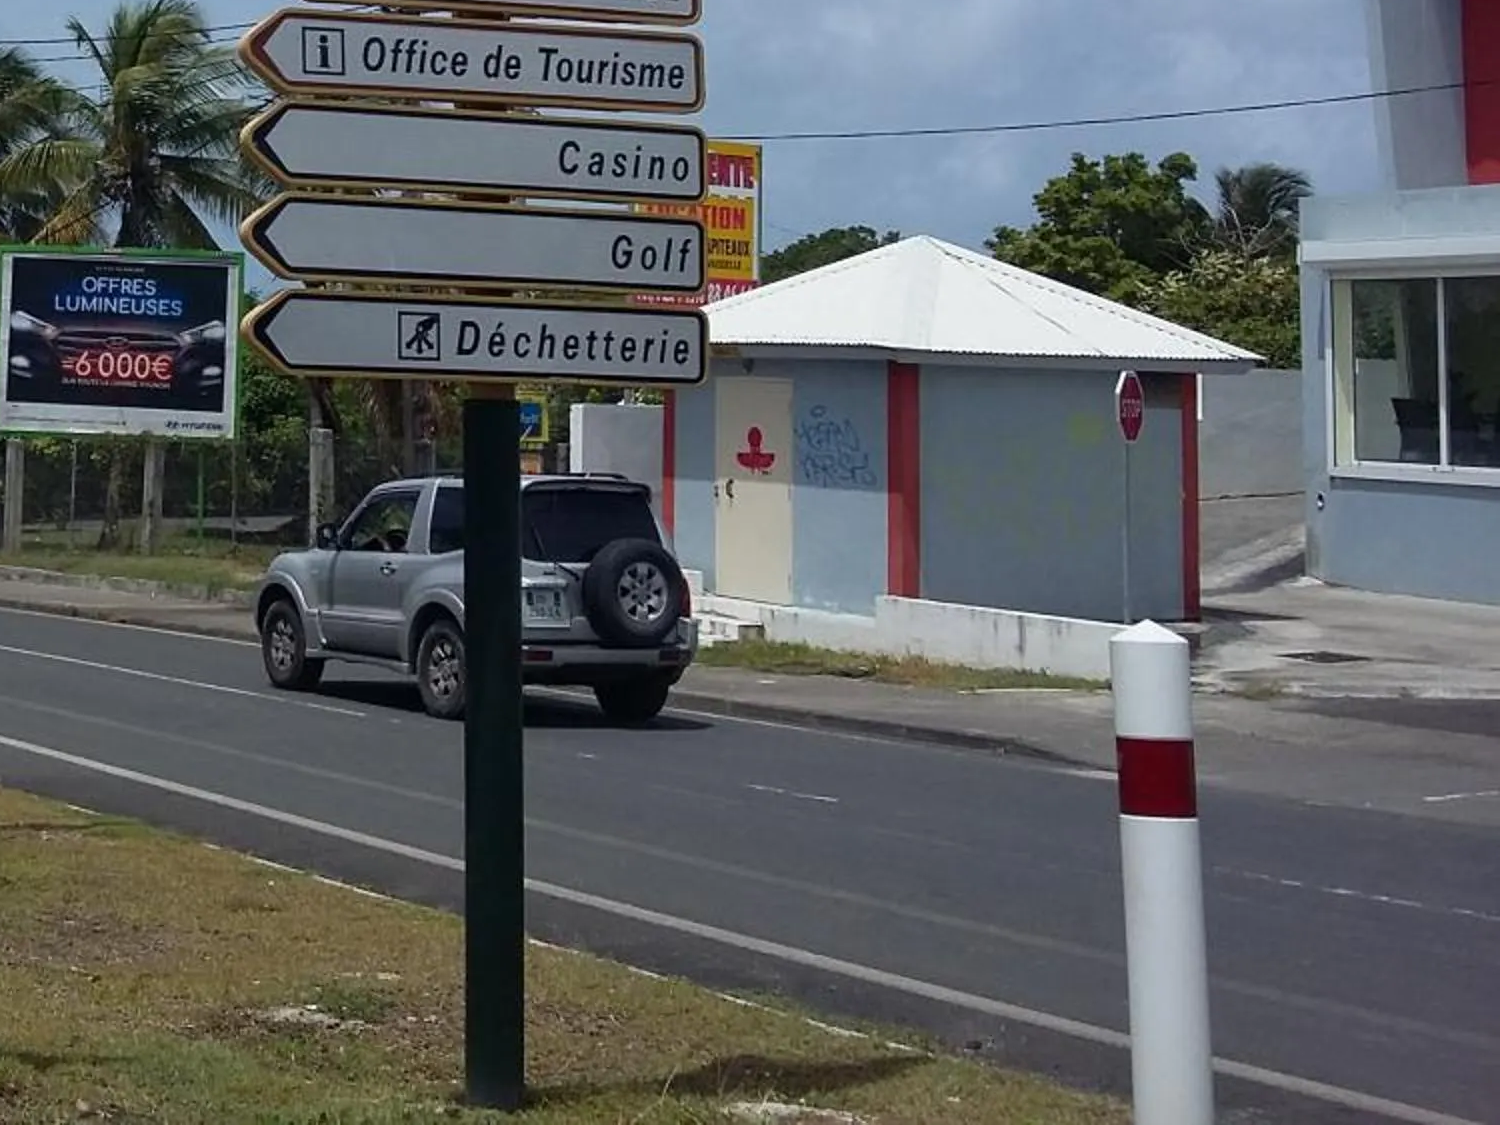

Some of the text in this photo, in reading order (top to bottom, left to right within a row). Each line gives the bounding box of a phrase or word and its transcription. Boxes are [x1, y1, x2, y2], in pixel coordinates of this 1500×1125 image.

[362, 36, 686, 91] Office de Tourisme
[558, 141, 690, 182] Casino
[708, 153, 754, 189] ENTE
[610, 235, 693, 274] Golf
[54, 296, 183, 316] LUMINEUSES
[82, 277, 157, 296] OFFRES
[455, 319, 690, 366] Déchetterie
